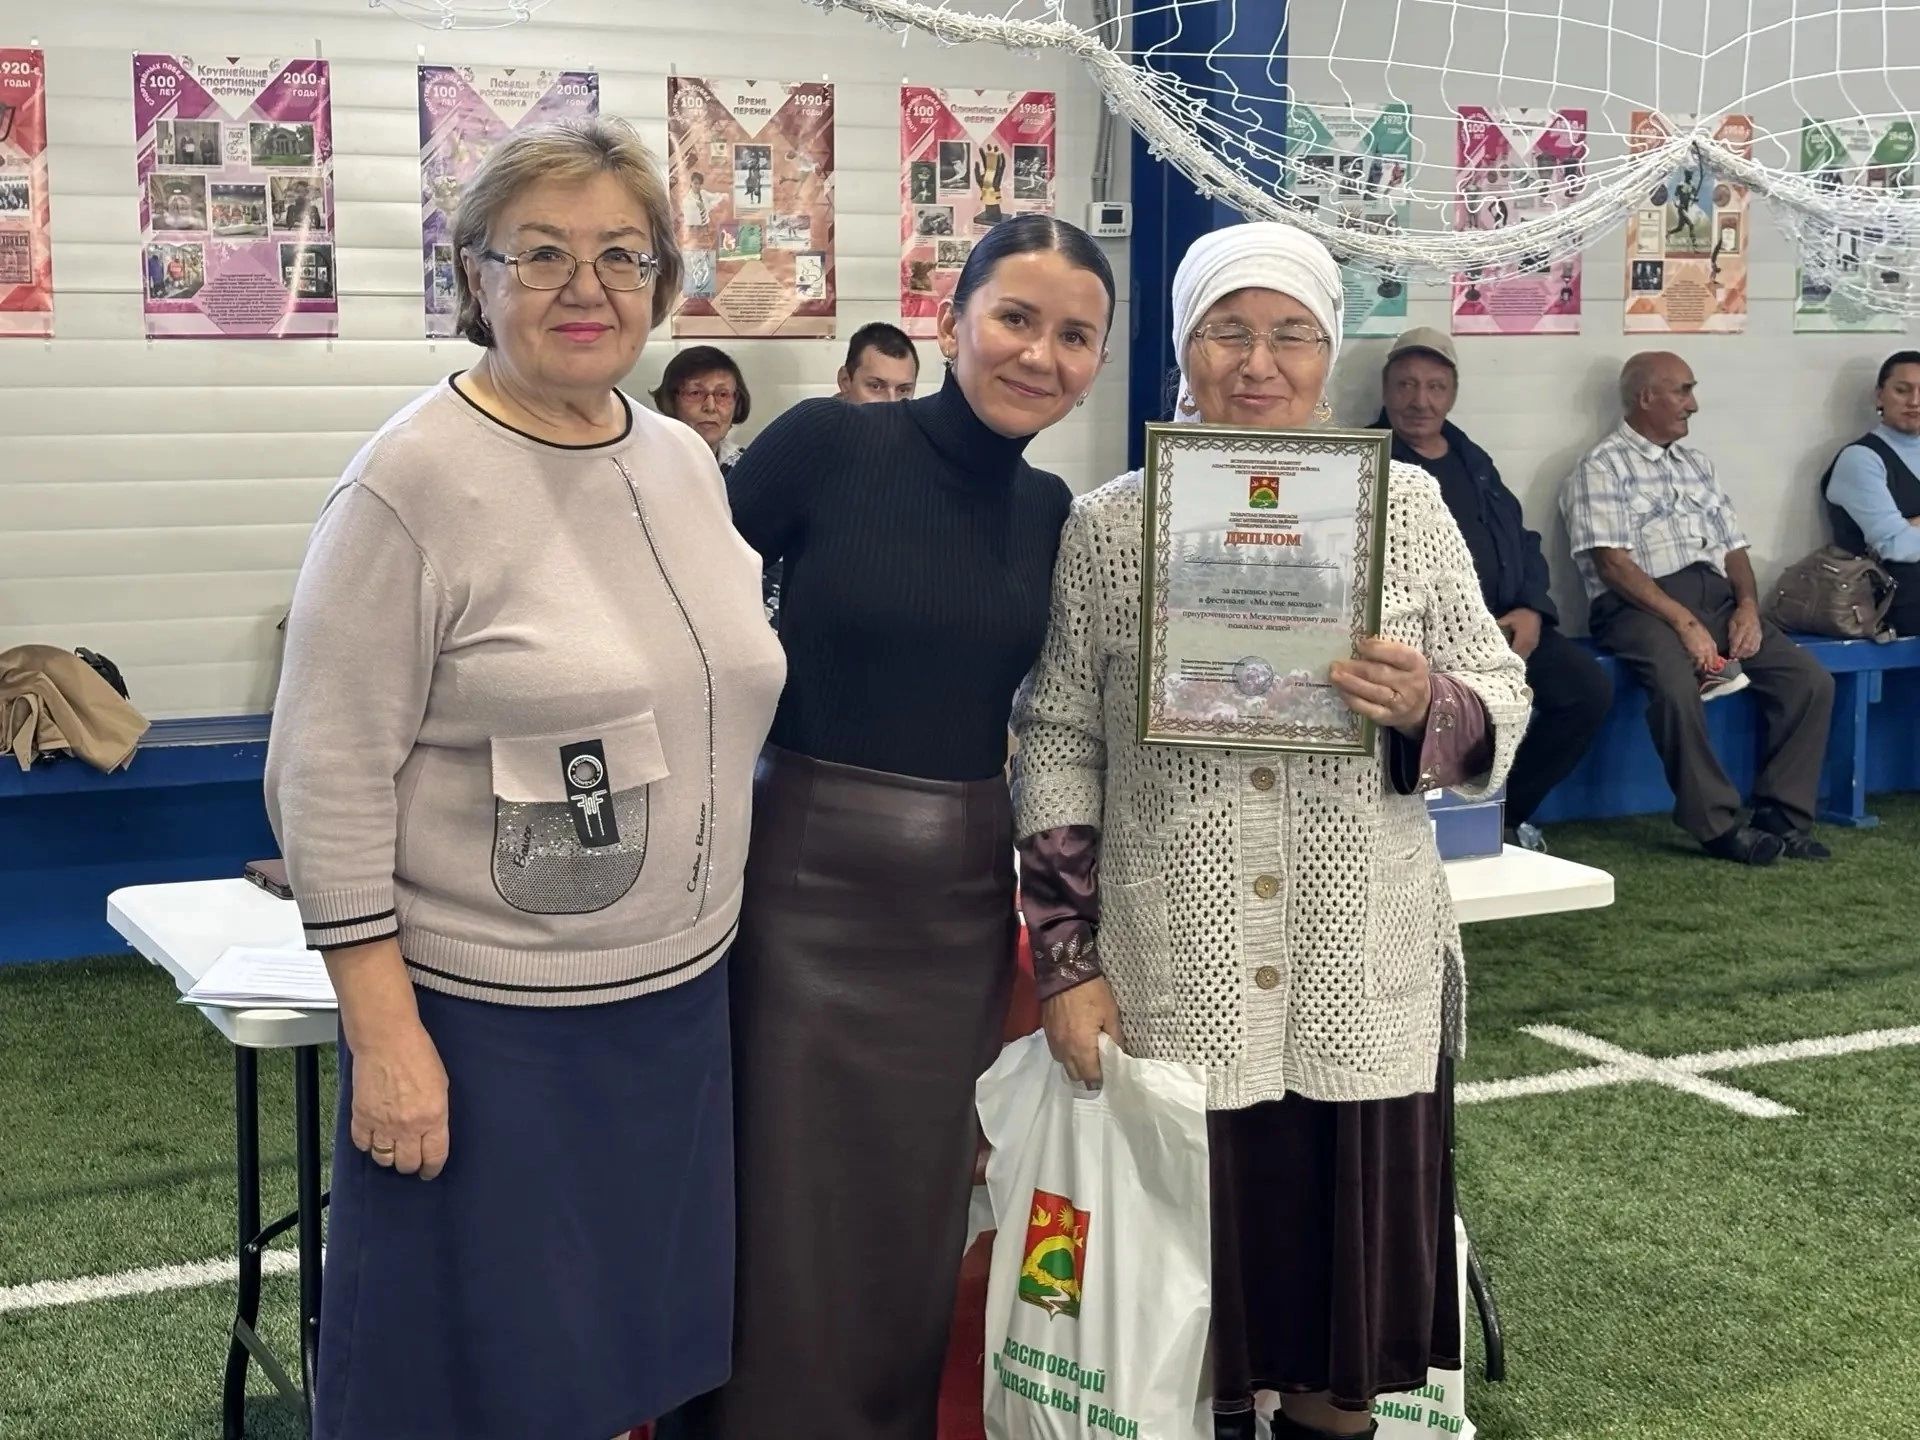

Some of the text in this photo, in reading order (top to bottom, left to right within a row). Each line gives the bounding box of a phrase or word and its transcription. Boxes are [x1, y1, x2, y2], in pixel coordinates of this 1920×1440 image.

[0, 62, 40, 75] 920-е
[150, 75, 176, 88] 100
[200, 77, 267, 87] СПОРТИВНЫЕ
[212, 87, 256, 96] ФОРУМЫ
[433, 86, 457, 98] 100
[480, 89, 541, 99] РОССИЙСКОГО
[494, 99, 527, 107] СПОРТА
[680, 96, 704, 108] 100
[733, 107, 772, 115] ПЕРЕМЕН
[913, 106, 934, 117] 100
[1224, 531, 1302, 546] ДИПЛОМ
[1231, 588, 1267, 596] активное
[1204, 597, 1246, 605] фестивале
[1250, 613, 1319, 623] Международному
[1427, 1409, 1464, 1434] рай
